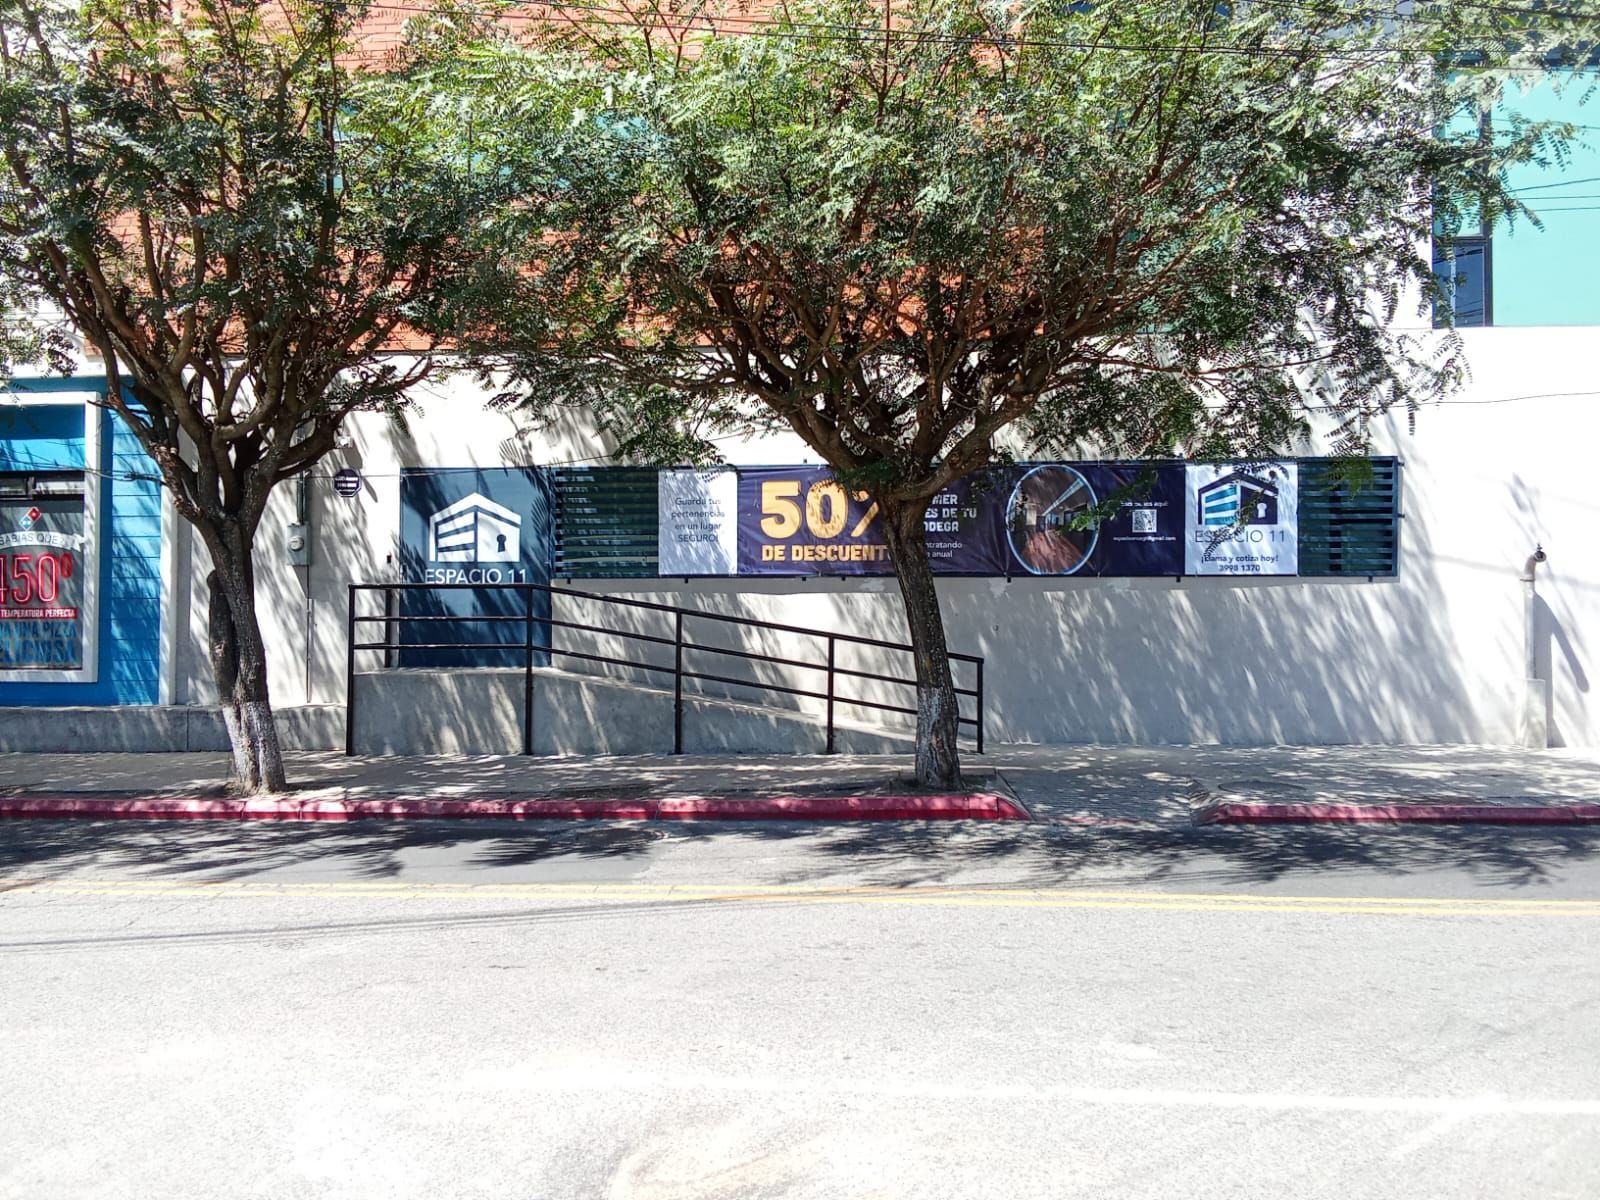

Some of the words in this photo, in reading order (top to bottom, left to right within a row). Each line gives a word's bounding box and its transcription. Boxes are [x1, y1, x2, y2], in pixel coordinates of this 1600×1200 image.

[675, 497, 707, 506] Guarda
[942, 508, 958, 518] DE
[1270, 530, 1285, 543] 11
[762, 544, 786, 561] DE
[932, 550, 953, 558] anual
[1242, 564, 1261, 573] 1370
[424, 568, 502, 585] ESPACIO
[507, 568, 528, 585] 11
[1, 608, 44, 618] TEMPERATURA
[45, 608, 75, 618] PERFECTA
